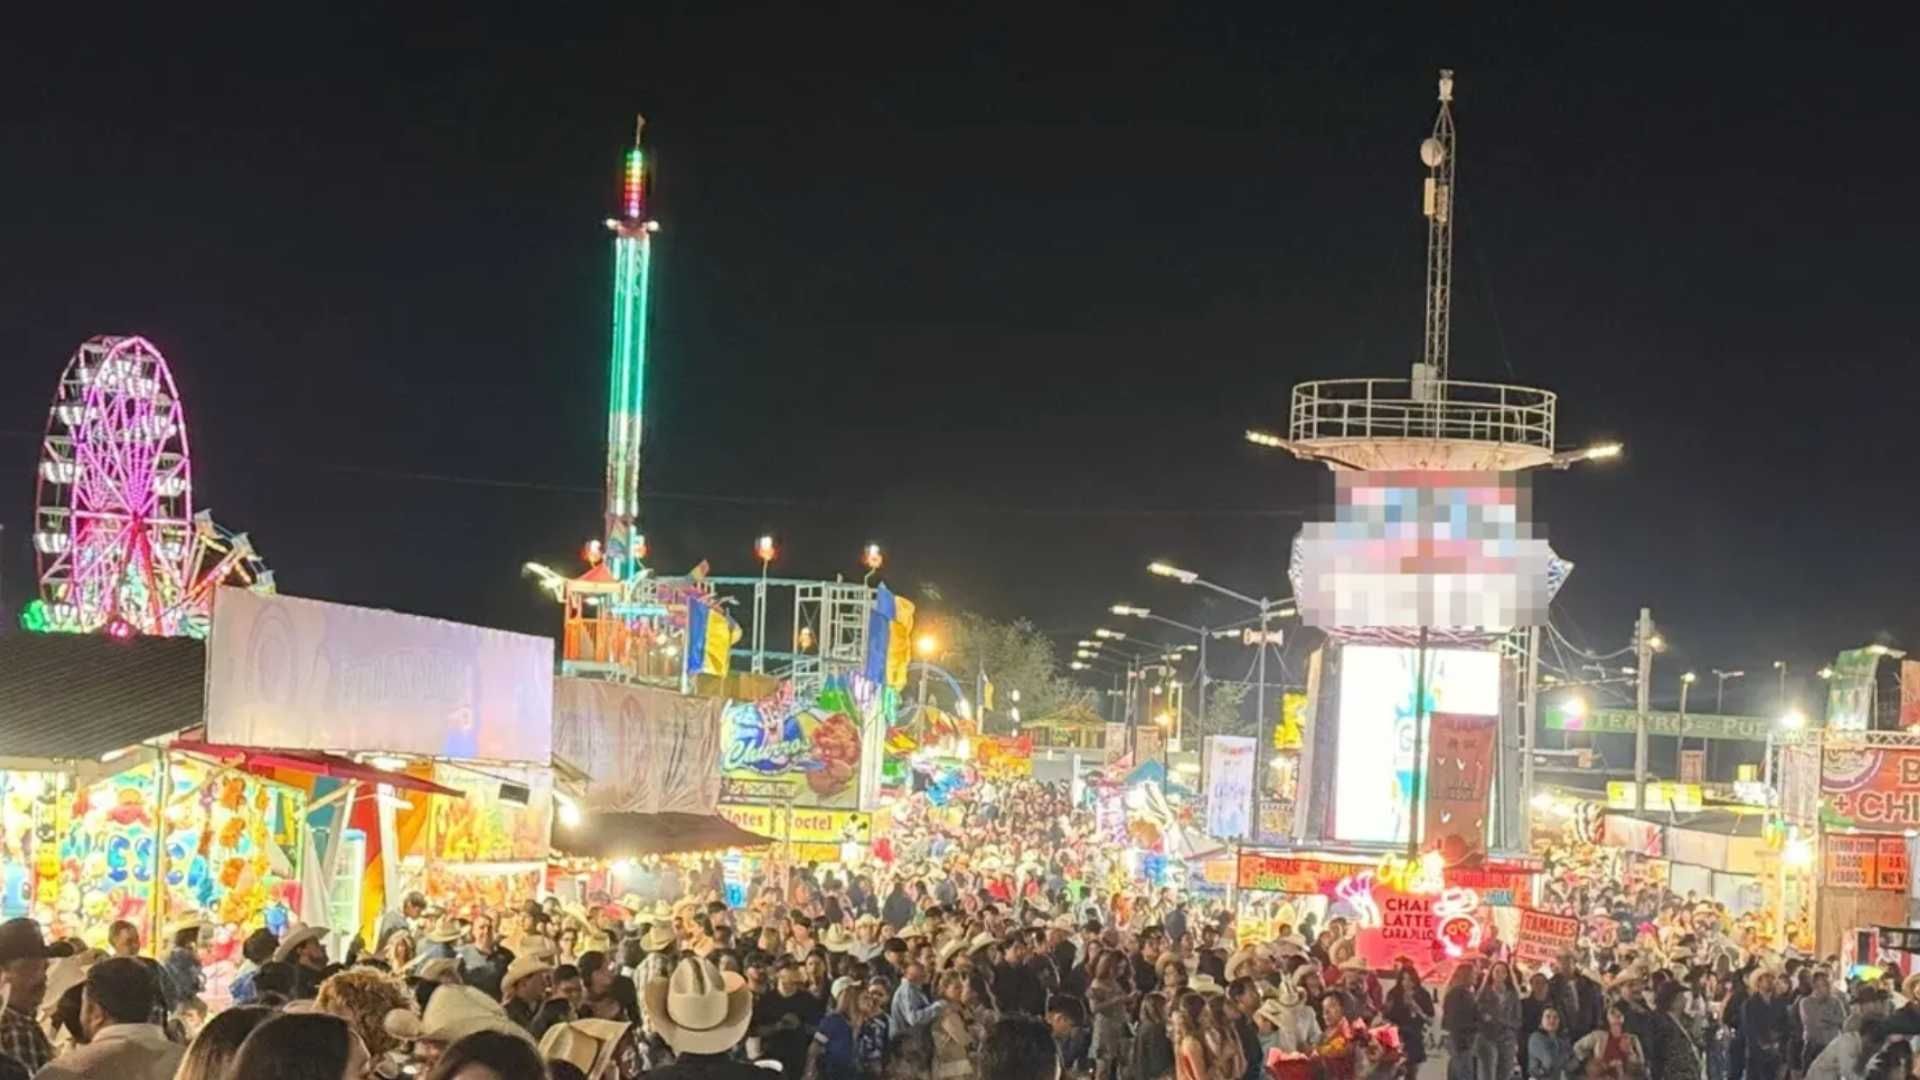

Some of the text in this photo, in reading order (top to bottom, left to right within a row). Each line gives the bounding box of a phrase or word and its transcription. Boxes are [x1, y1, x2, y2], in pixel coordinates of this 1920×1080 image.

[1600, 711, 1692, 733] TEARO
[726, 807, 764, 826] lotes
[784, 814, 832, 830] octel
[1385, 898, 1429, 912] CHAI
[1383, 913, 1433, 928] LATTE
[1524, 913, 1577, 937] TAMALES
